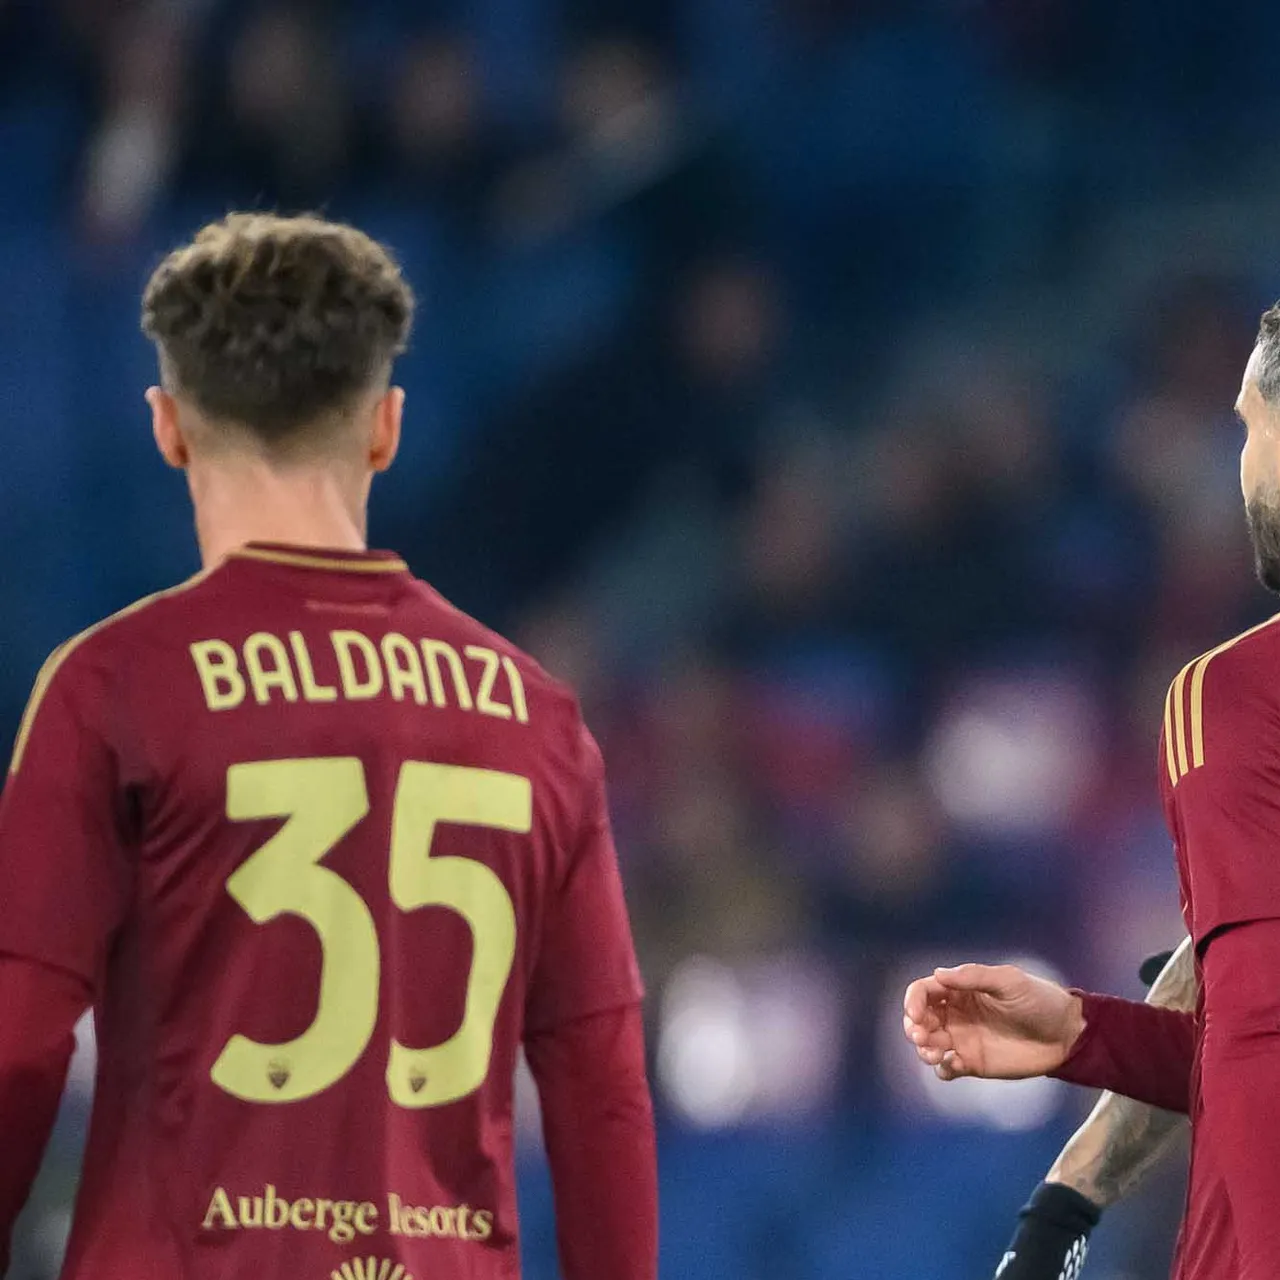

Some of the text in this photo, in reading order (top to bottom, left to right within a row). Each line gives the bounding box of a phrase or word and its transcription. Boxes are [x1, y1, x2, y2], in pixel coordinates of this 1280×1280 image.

[190, 630, 529, 723] BALDANZI
[210, 757, 533, 1108] 35
[202, 1184, 378, 1243] Auberge
